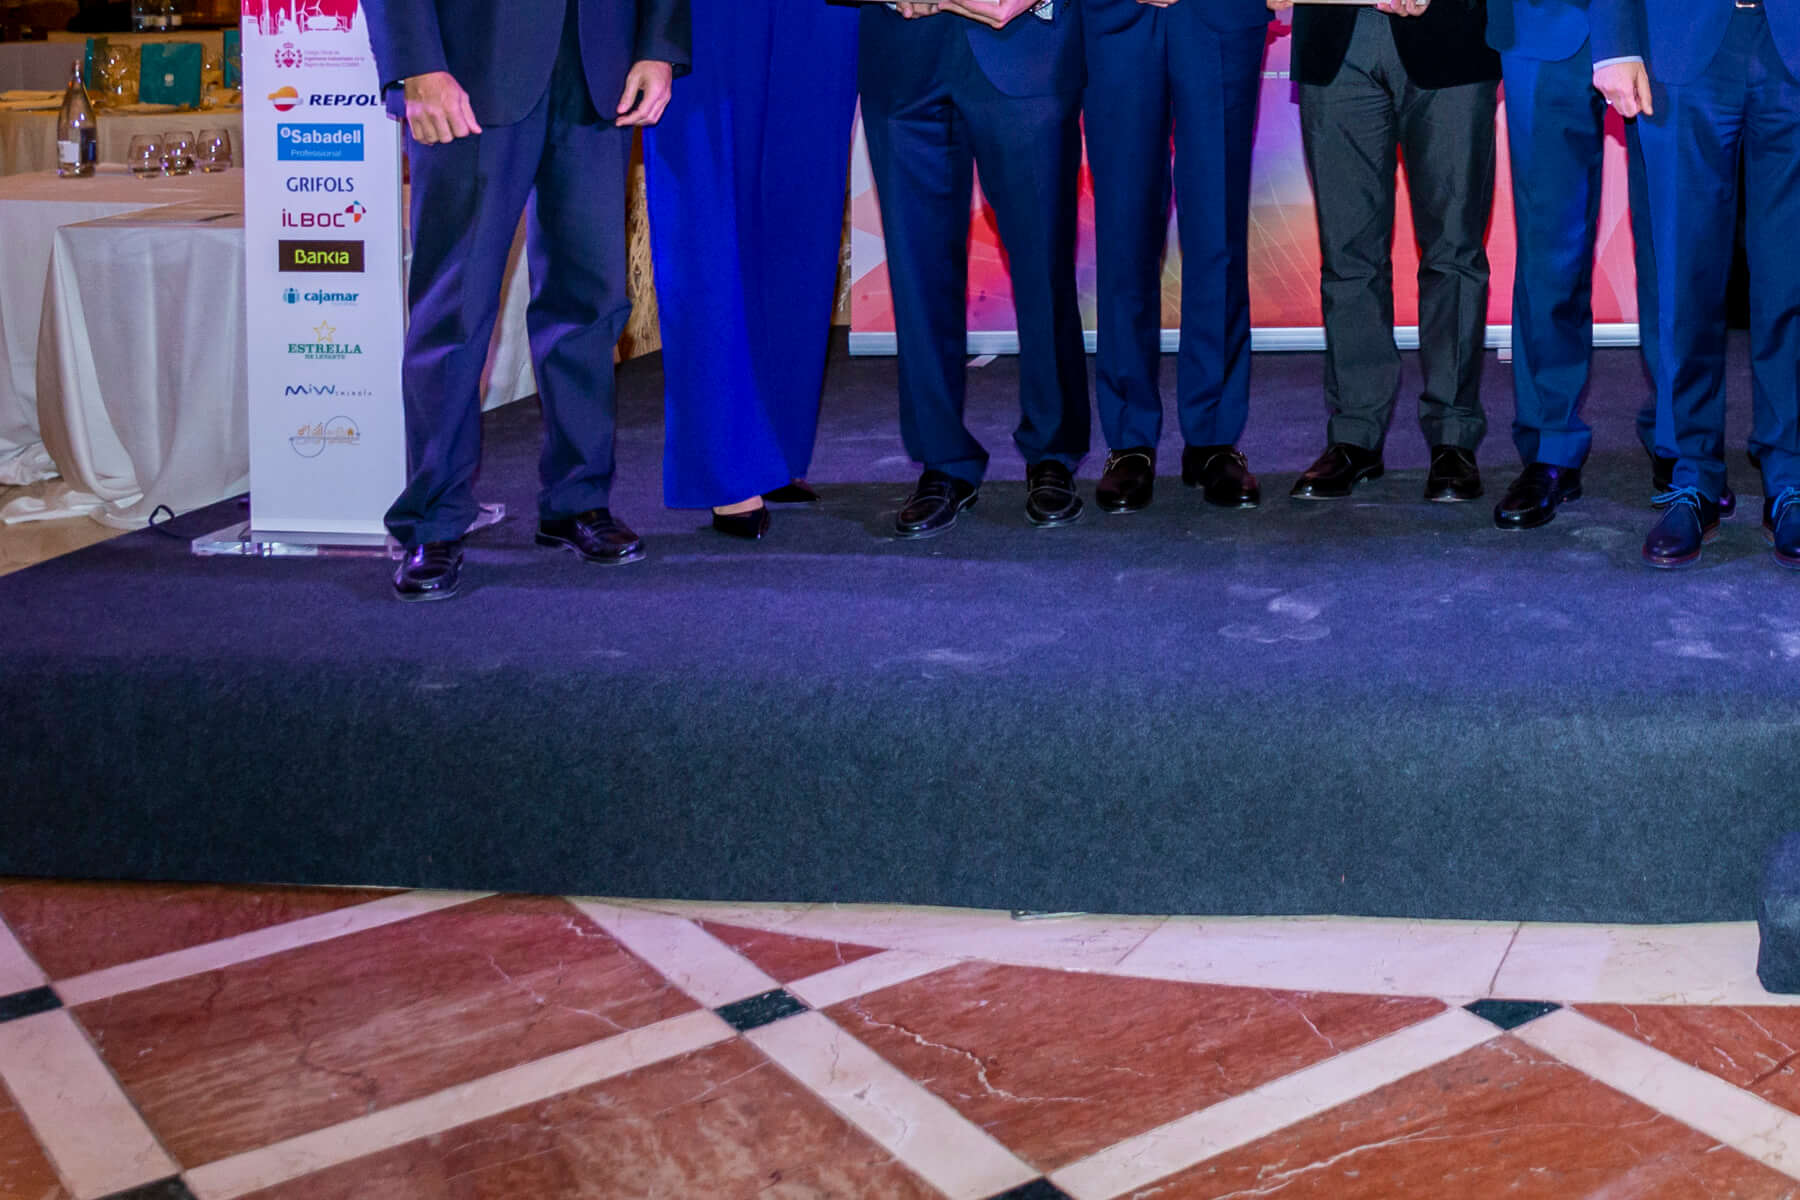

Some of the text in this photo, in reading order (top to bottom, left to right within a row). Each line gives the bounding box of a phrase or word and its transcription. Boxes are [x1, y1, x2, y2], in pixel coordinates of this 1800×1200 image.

[309, 94, 378, 106] REPSOL
[291, 129, 361, 144] Sabadell
[286, 177, 354, 192] GRIFOLS
[294, 249, 350, 265] Bankia
[303, 289, 360, 305] cajamar
[287, 343, 363, 354] ESTRELLA
